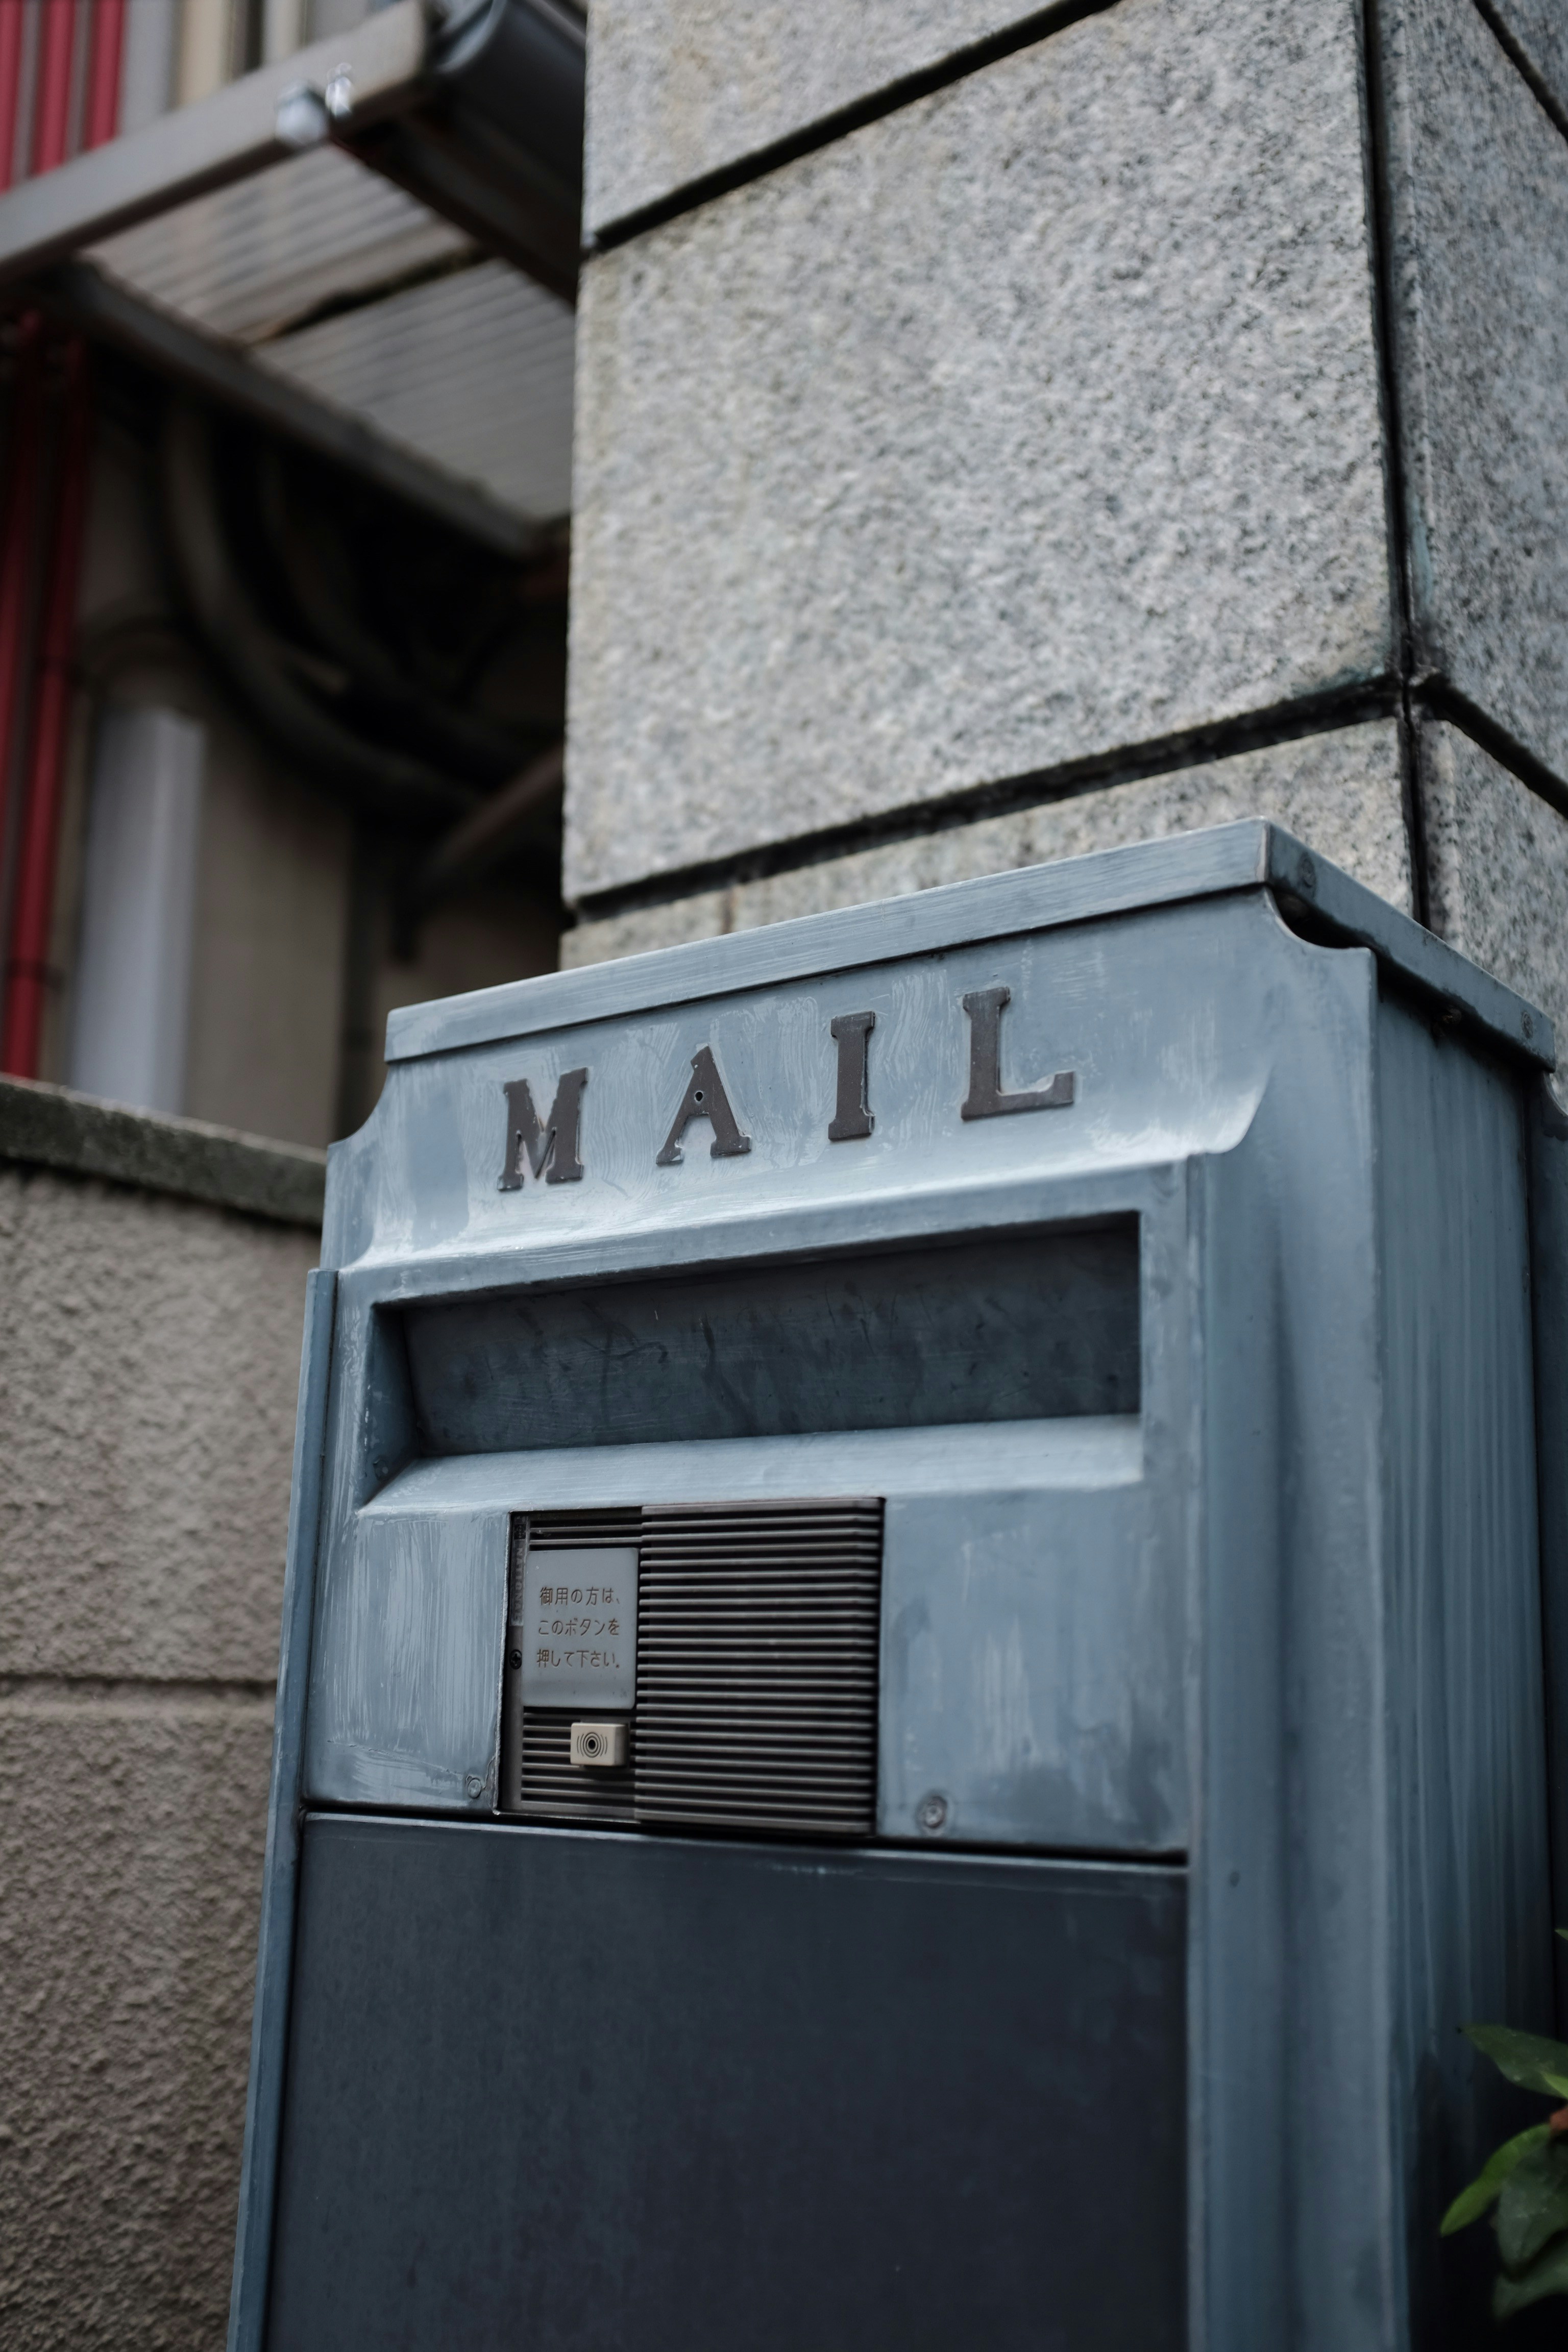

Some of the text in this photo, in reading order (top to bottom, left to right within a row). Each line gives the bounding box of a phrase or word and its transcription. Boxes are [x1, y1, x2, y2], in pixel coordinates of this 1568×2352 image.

[497, 987, 1075, 1191] MAIL
[514, 1548, 523, 1620] NATIONAL
[540, 1586, 620, 1606] 御用の方は、
[538, 1618, 619, 1636] このボタンを
